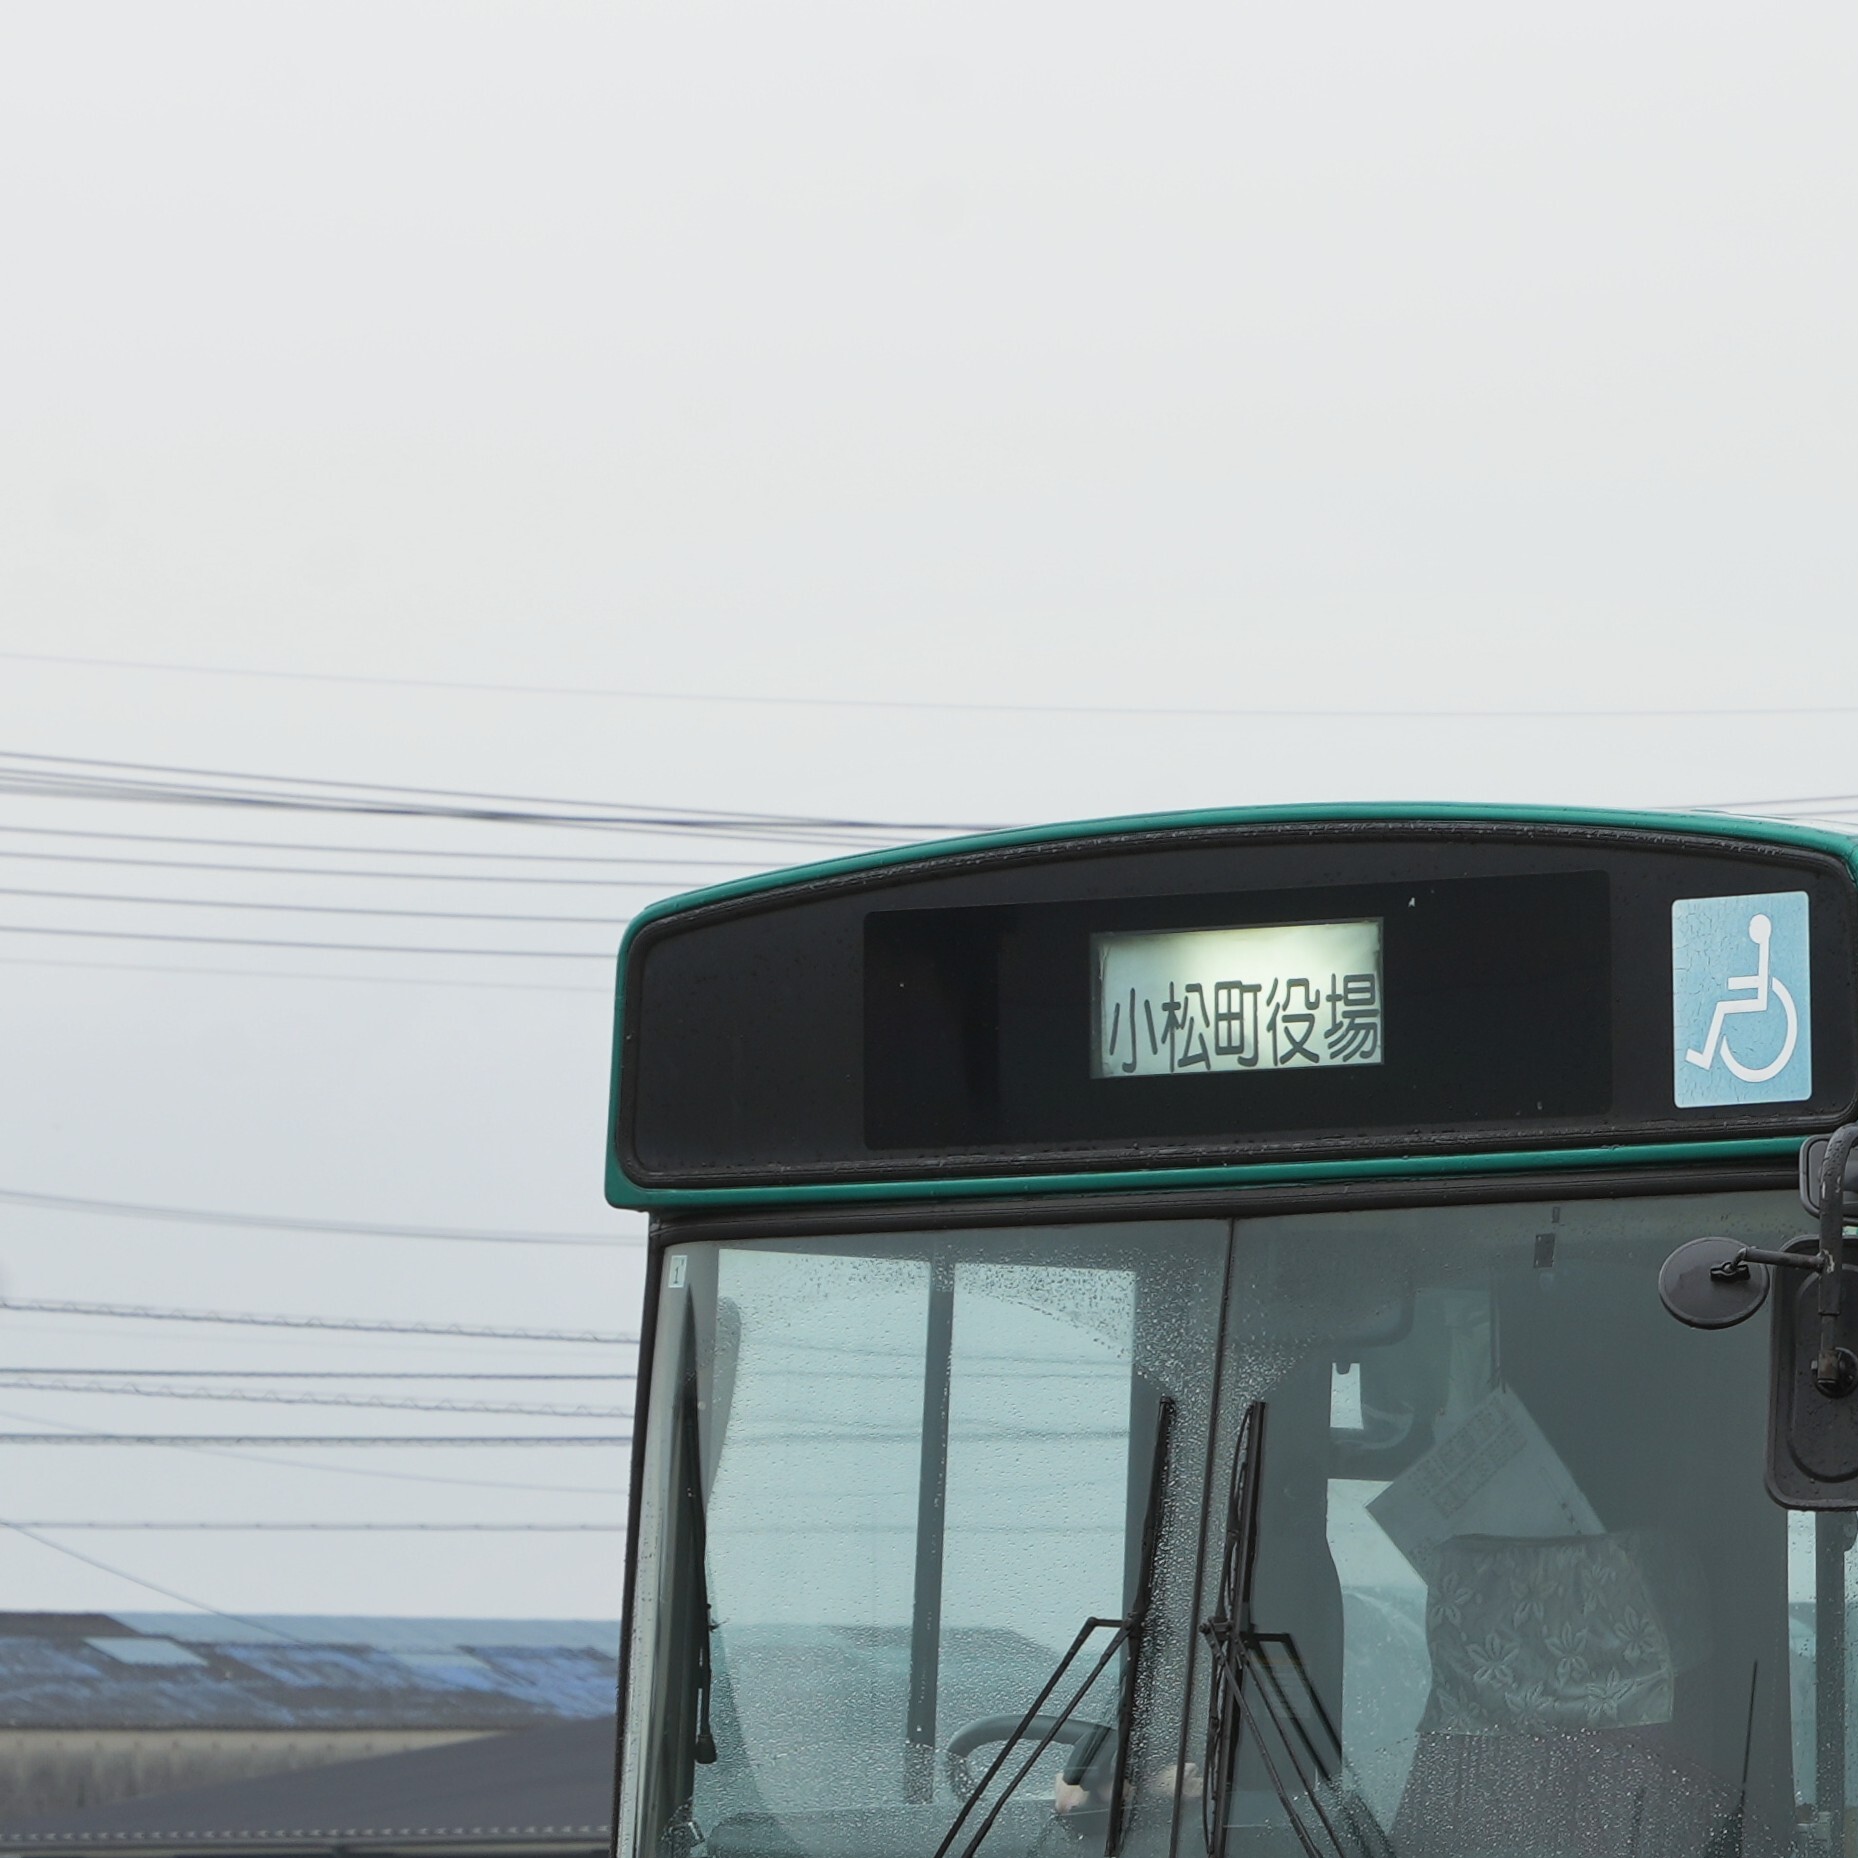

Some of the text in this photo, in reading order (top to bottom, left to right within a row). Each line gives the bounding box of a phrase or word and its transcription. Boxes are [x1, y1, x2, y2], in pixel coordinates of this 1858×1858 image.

[1109, 973, 1381, 1074] 小松町役場
